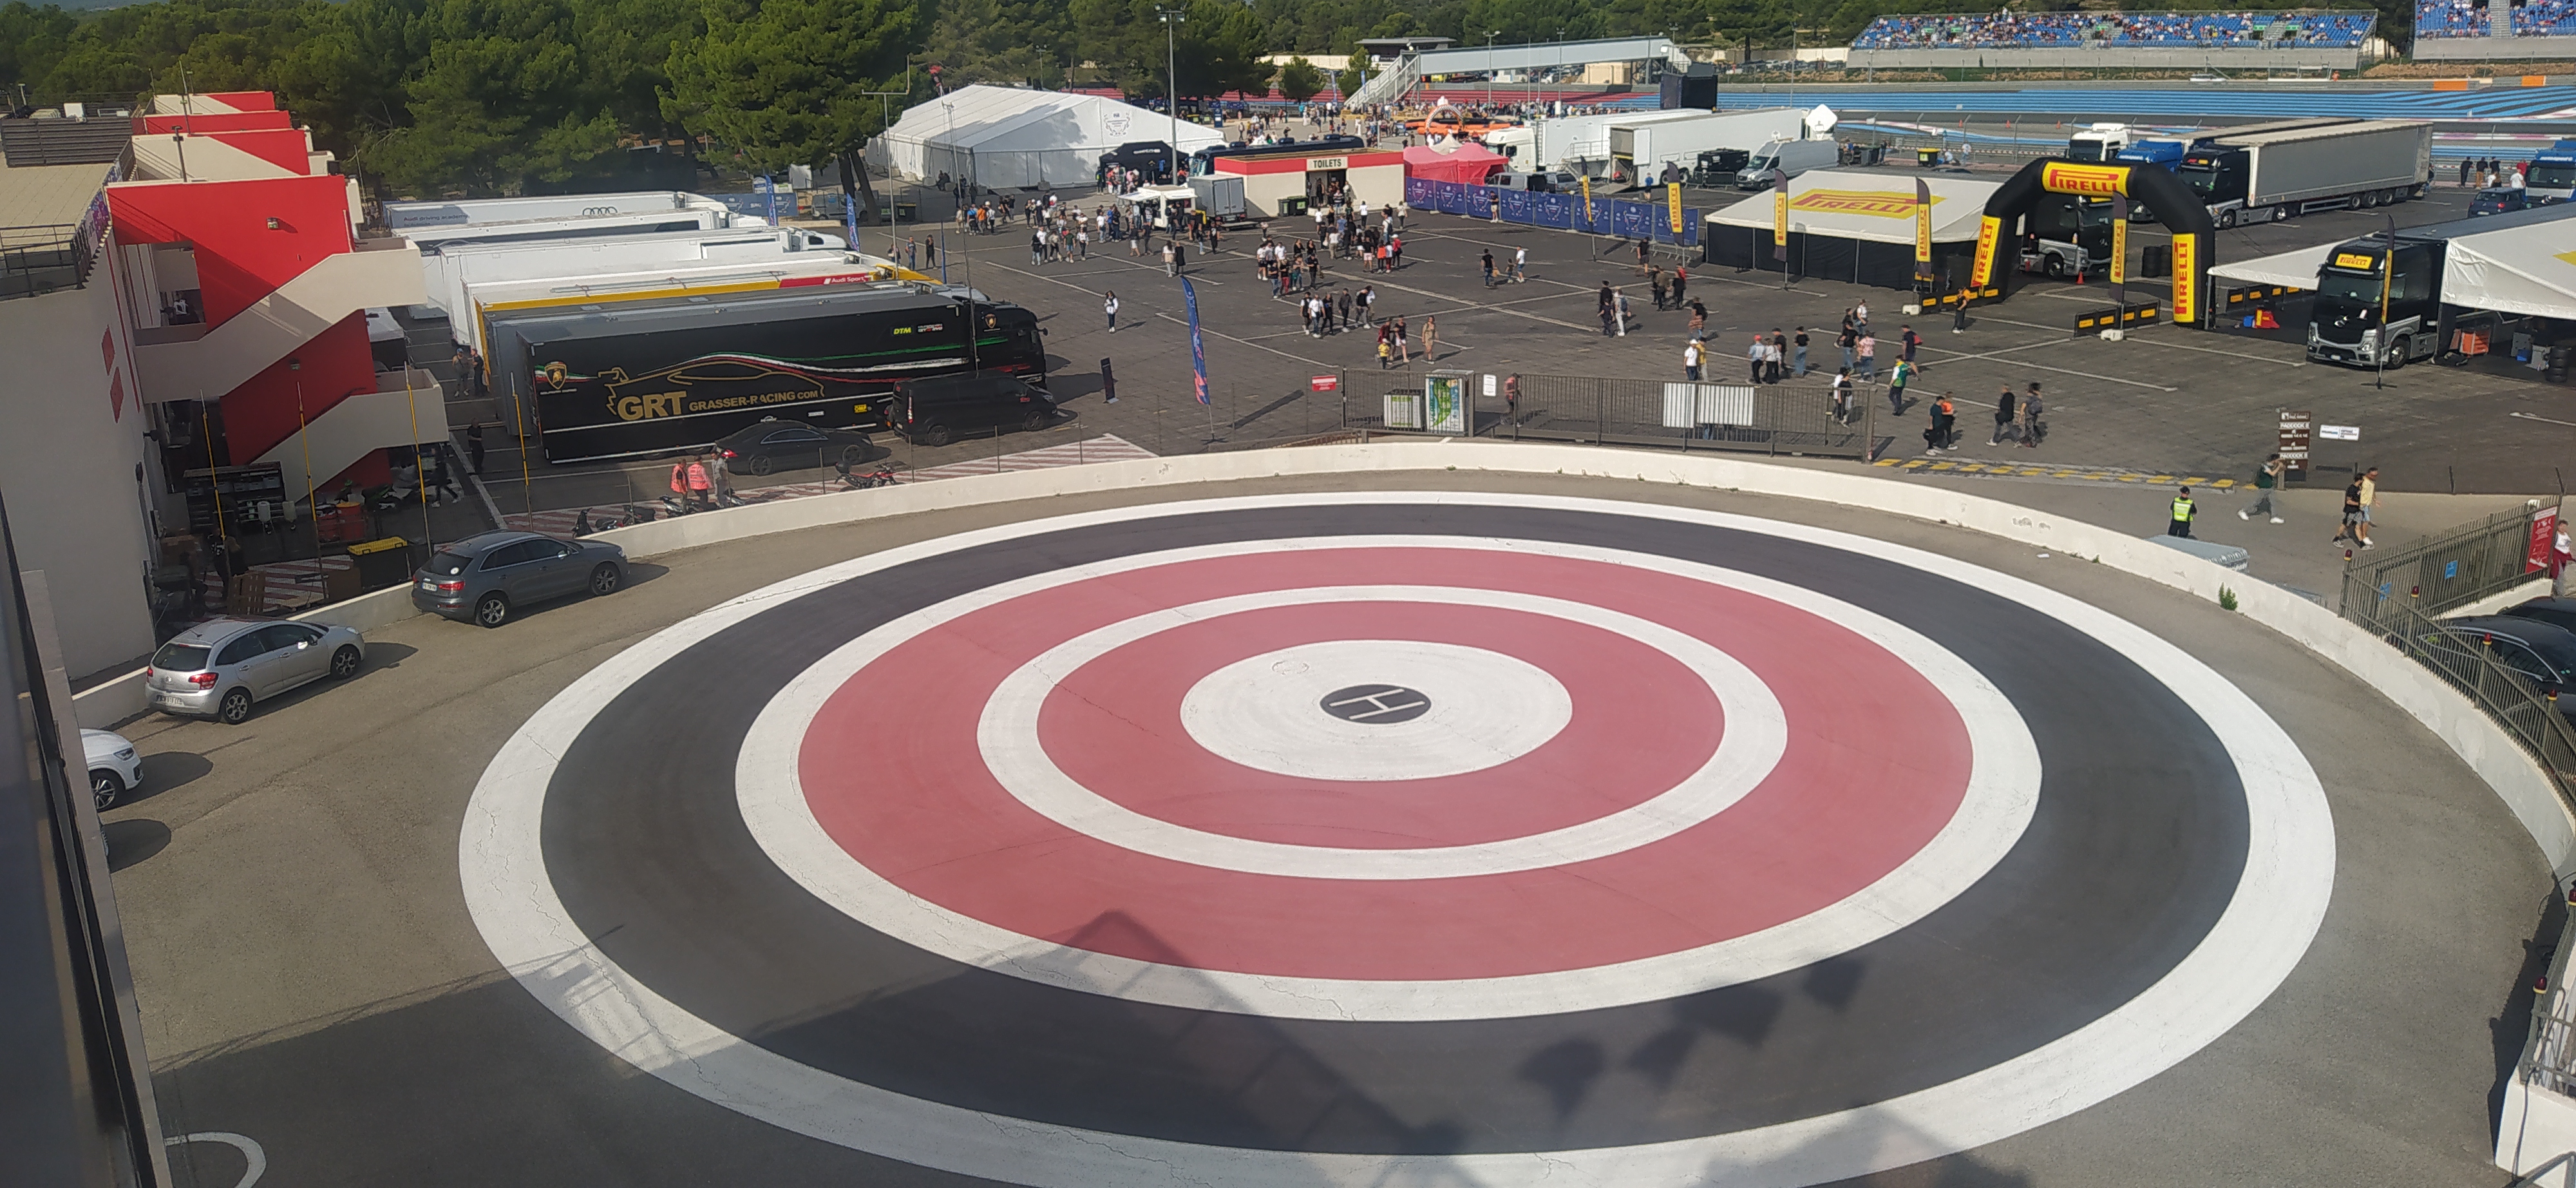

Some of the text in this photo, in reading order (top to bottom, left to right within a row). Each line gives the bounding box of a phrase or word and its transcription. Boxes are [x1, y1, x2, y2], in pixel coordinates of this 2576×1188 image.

[1313, 158, 1342, 168] TOILETS
[2049, 169, 2119, 193] PIRELLI
[1792, 193, 1918, 214] PIRELLI
[1971, 222, 1994, 287] PIRELLI
[2174, 242, 2188, 315] PIRELLI
[617, 390, 688, 421] GRT
[1329, 689, 1426, 720] H
